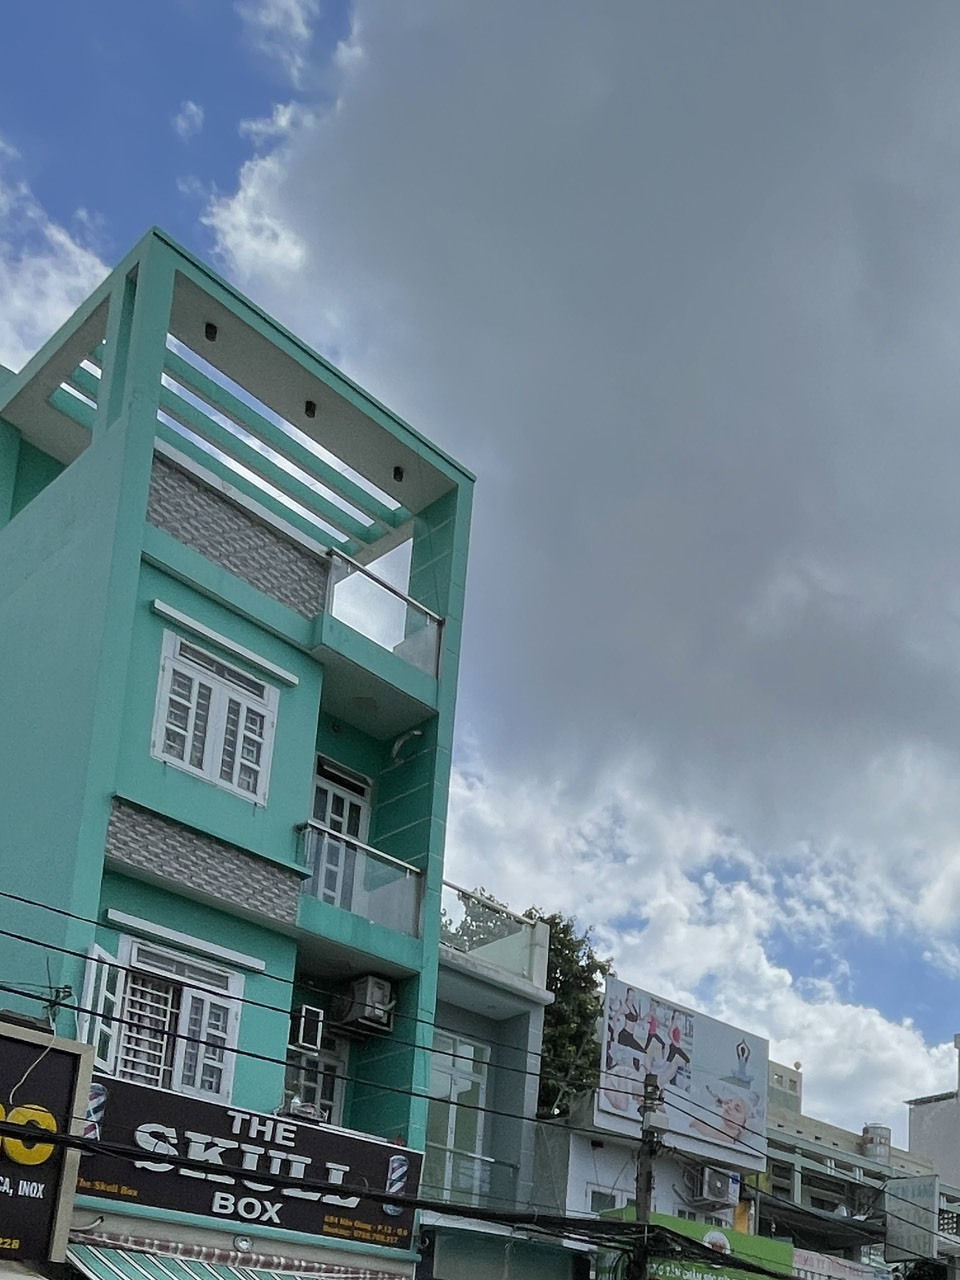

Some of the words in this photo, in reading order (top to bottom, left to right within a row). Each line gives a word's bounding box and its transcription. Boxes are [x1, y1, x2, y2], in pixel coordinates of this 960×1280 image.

[227, 1110, 298, 1147] THE
[134, 1123, 360, 1208] SKULL
[18, 1180, 45, 1198] INOX
[120, 1186, 138, 1197] Box
[212, 1192, 283, 1224] BOX
